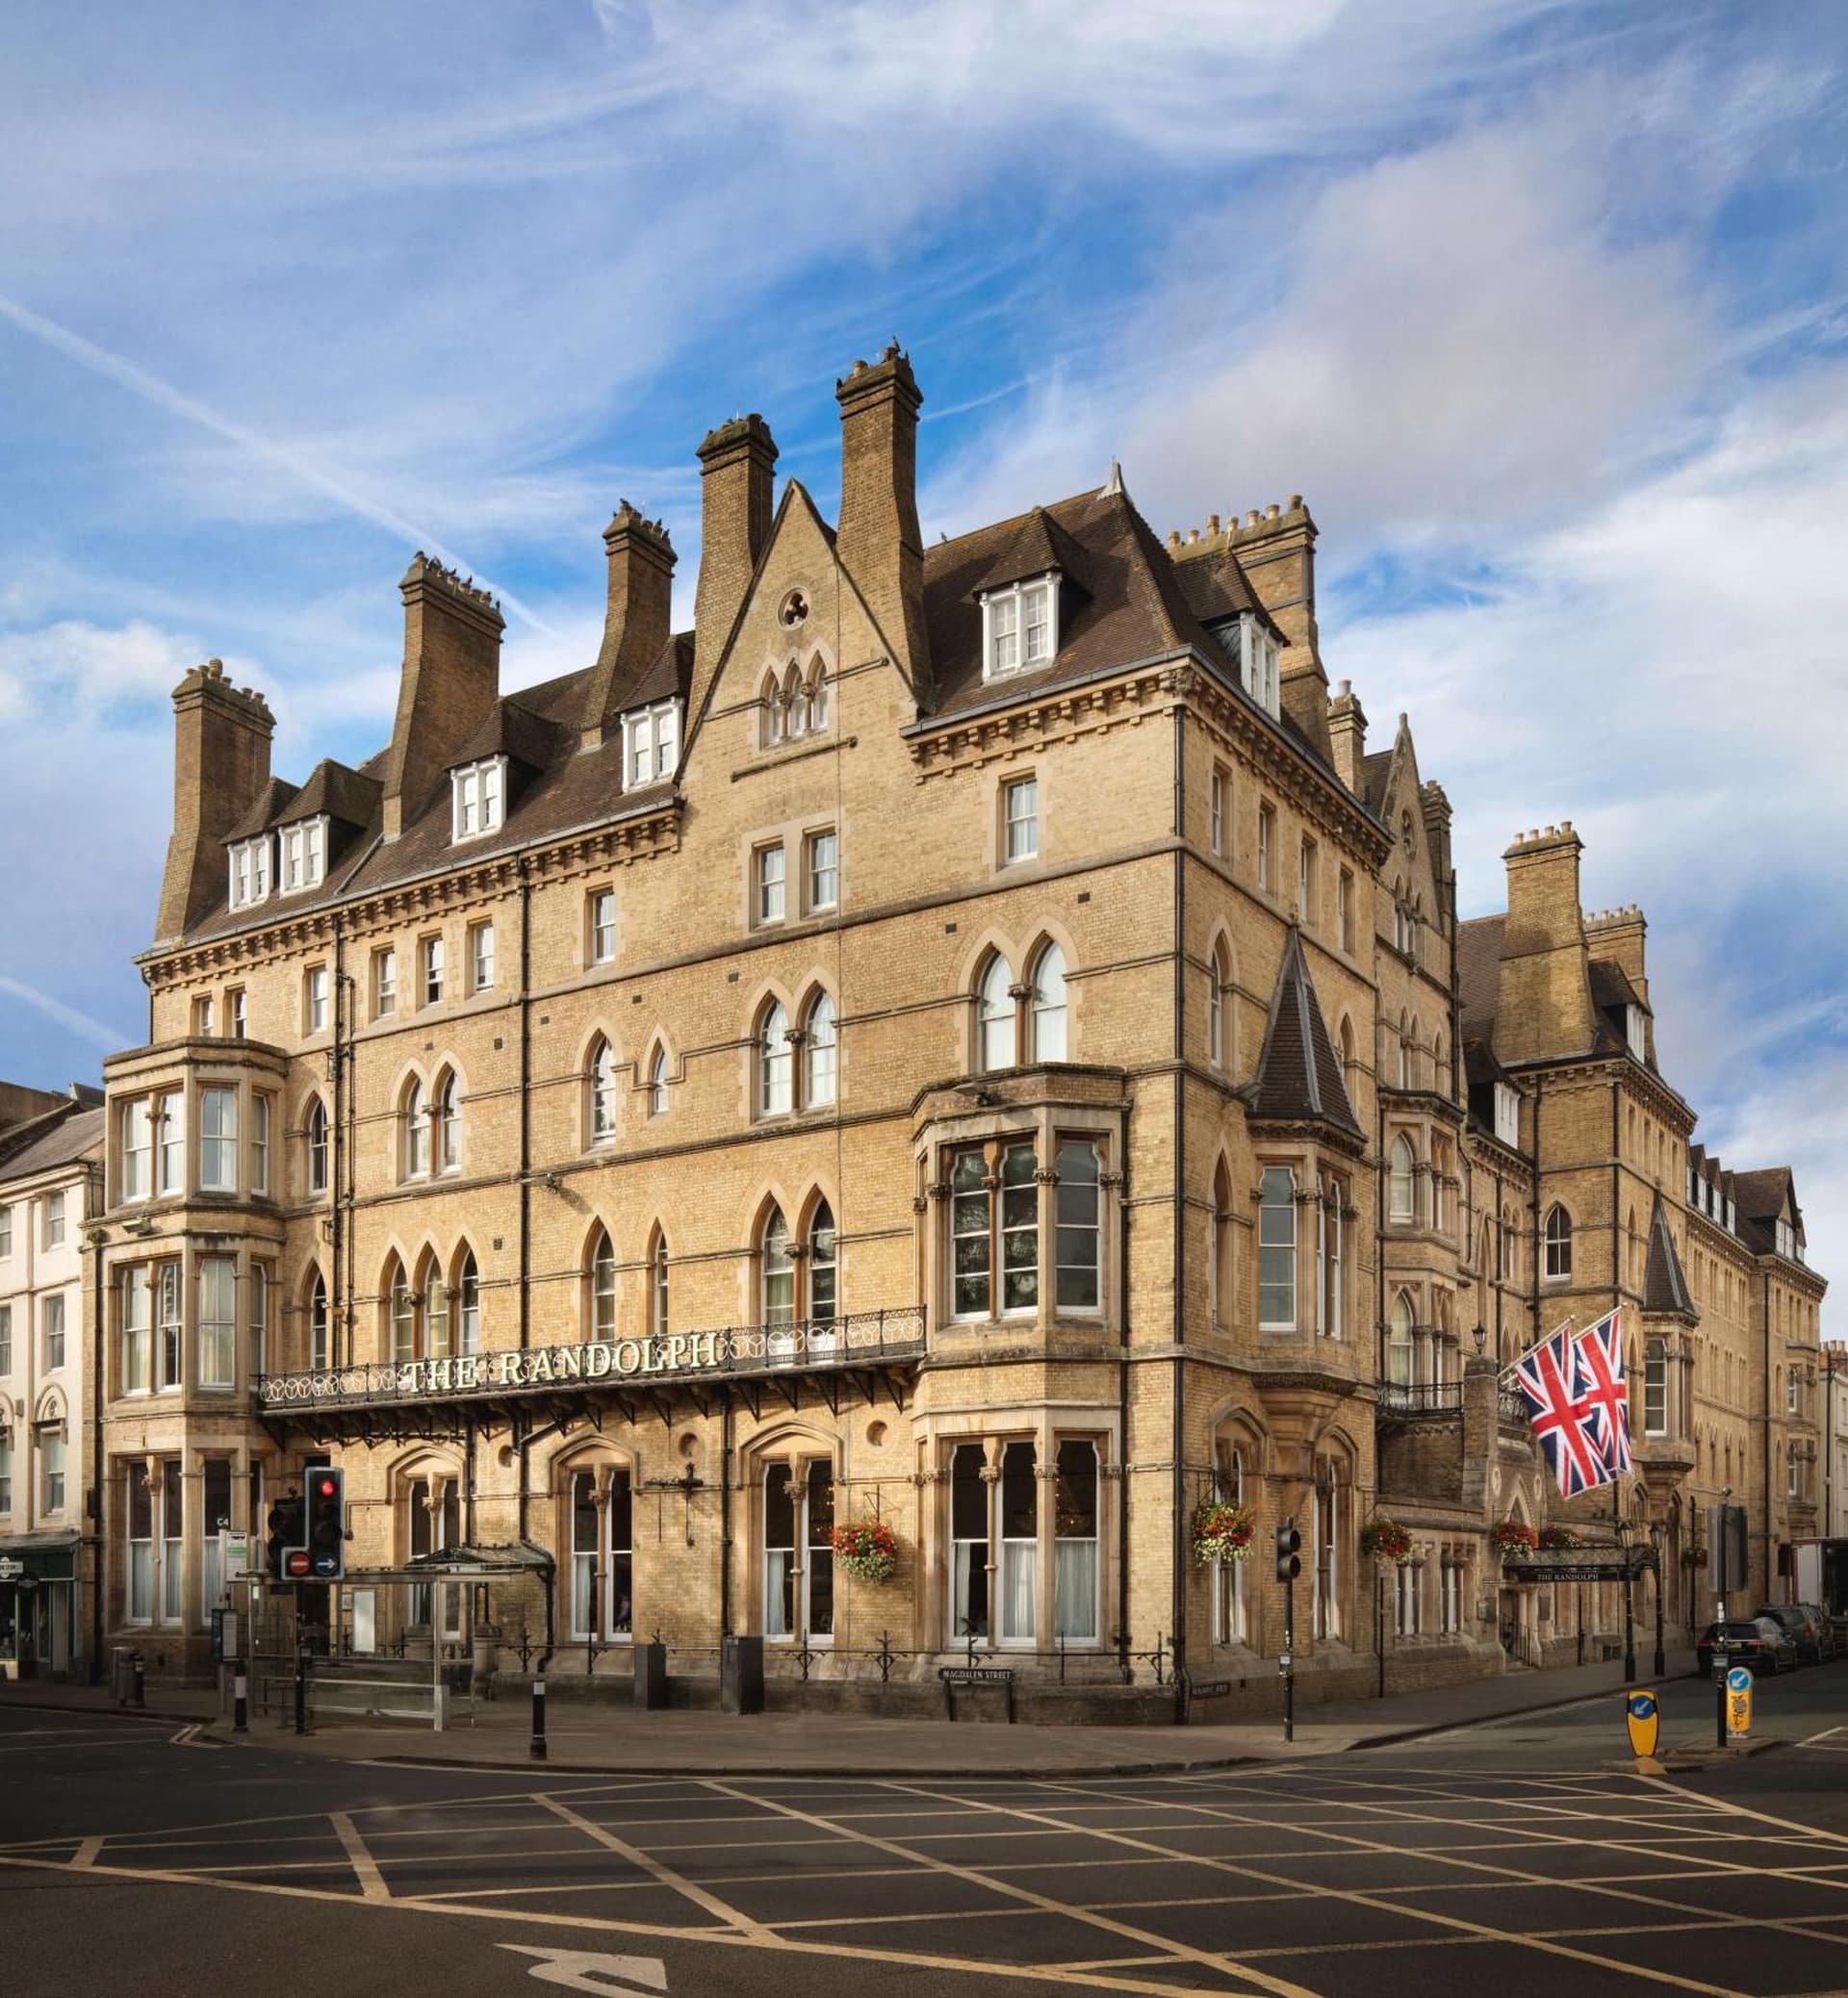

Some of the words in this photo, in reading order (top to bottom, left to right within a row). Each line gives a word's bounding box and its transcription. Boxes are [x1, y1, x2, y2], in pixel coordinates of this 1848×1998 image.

[402, 1356, 478, 1393] THE
[499, 1333, 718, 1385] RANDOLPH
[217, 1518, 229, 1526] C4
[1553, 1572, 1598, 1580] RANDOLPH
[943, 1670, 983, 1678] MAGDALEN
[985, 1670, 1012, 1678] STREET
